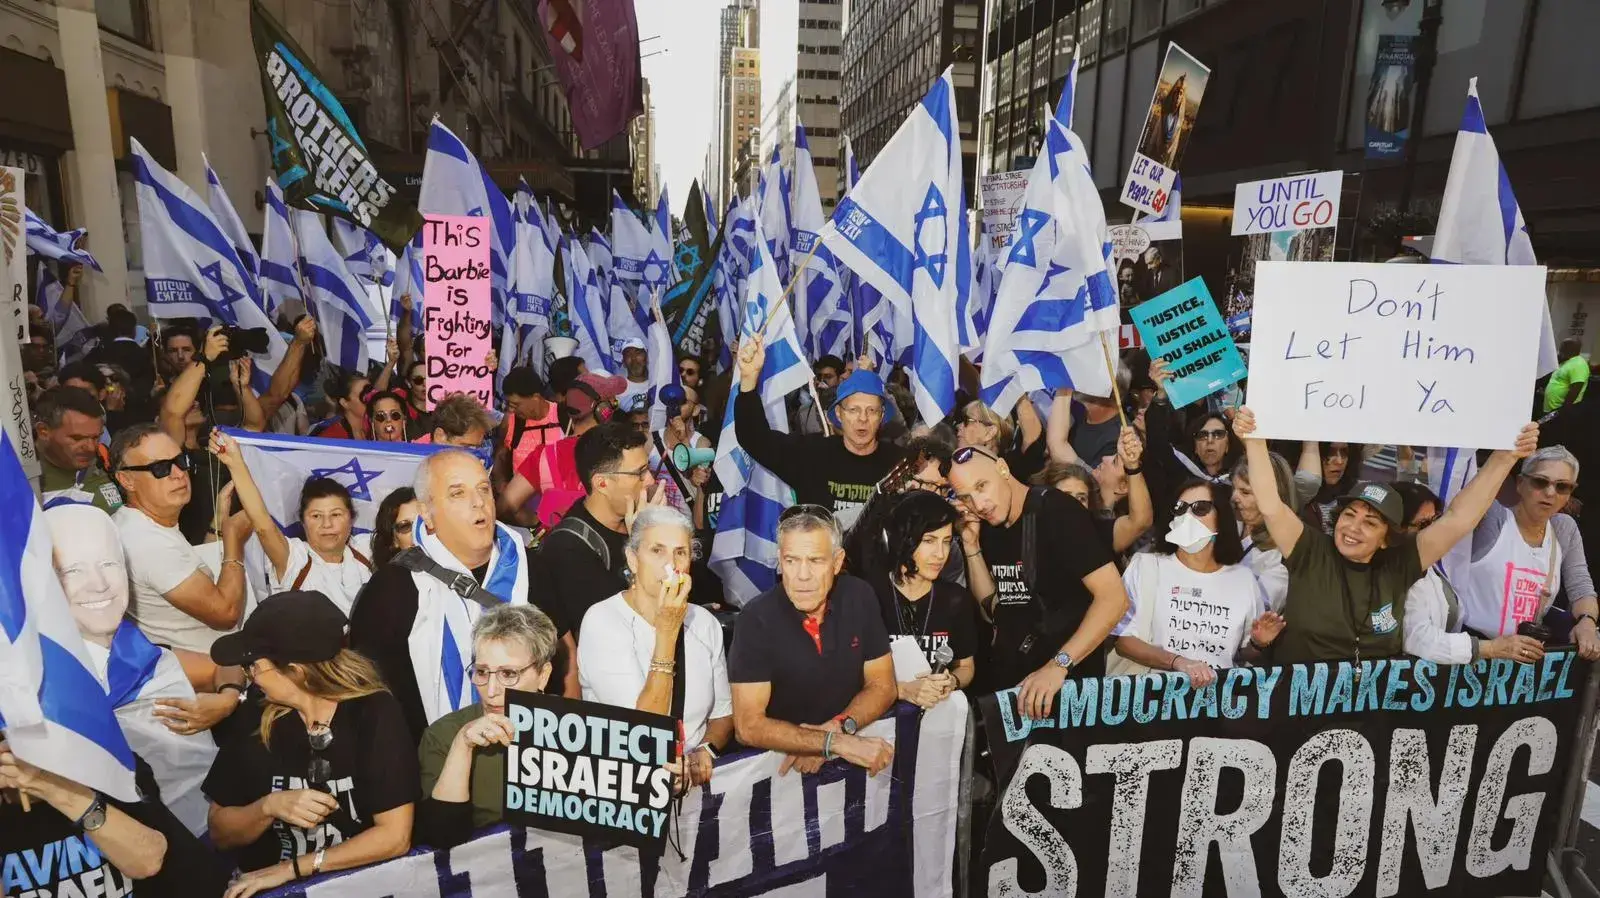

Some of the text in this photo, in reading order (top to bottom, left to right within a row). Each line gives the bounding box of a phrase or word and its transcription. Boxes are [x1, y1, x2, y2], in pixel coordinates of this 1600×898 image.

[267, 51, 397, 208] BROTHERS
[982, 180, 1029, 191] DICTATORSHIP
[986, 171, 1023, 182] FINAL STAGE
[1133, 156, 1164, 184] LET OUR
[1126, 180, 1167, 213] PEOPLE GO
[1259, 178, 1324, 204] UNTIL
[1245, 200, 1333, 231] YOU GO
[425, 254, 490, 283] Barbie
[447, 285, 469, 306] is
[1347, 278, 1444, 321] Don't
[425, 306, 491, 341] Fighting
[1156, 315, 1207, 346] JUSTICE
[446, 342, 472, 358] For
[1183, 328, 1227, 355] SHALL
[1285, 330, 1475, 364] Let Him
[1304, 380, 1455, 413] Fool Ya
[995, 650, 1577, 742] DMOCRACY MAKES ISRAEL
[509, 703, 674, 766] PROTECT
[507, 744, 672, 809] ISRAEL'S
[506, 783, 668, 839] DEMOCRACY
[987, 716, 1558, 898] STRONG
